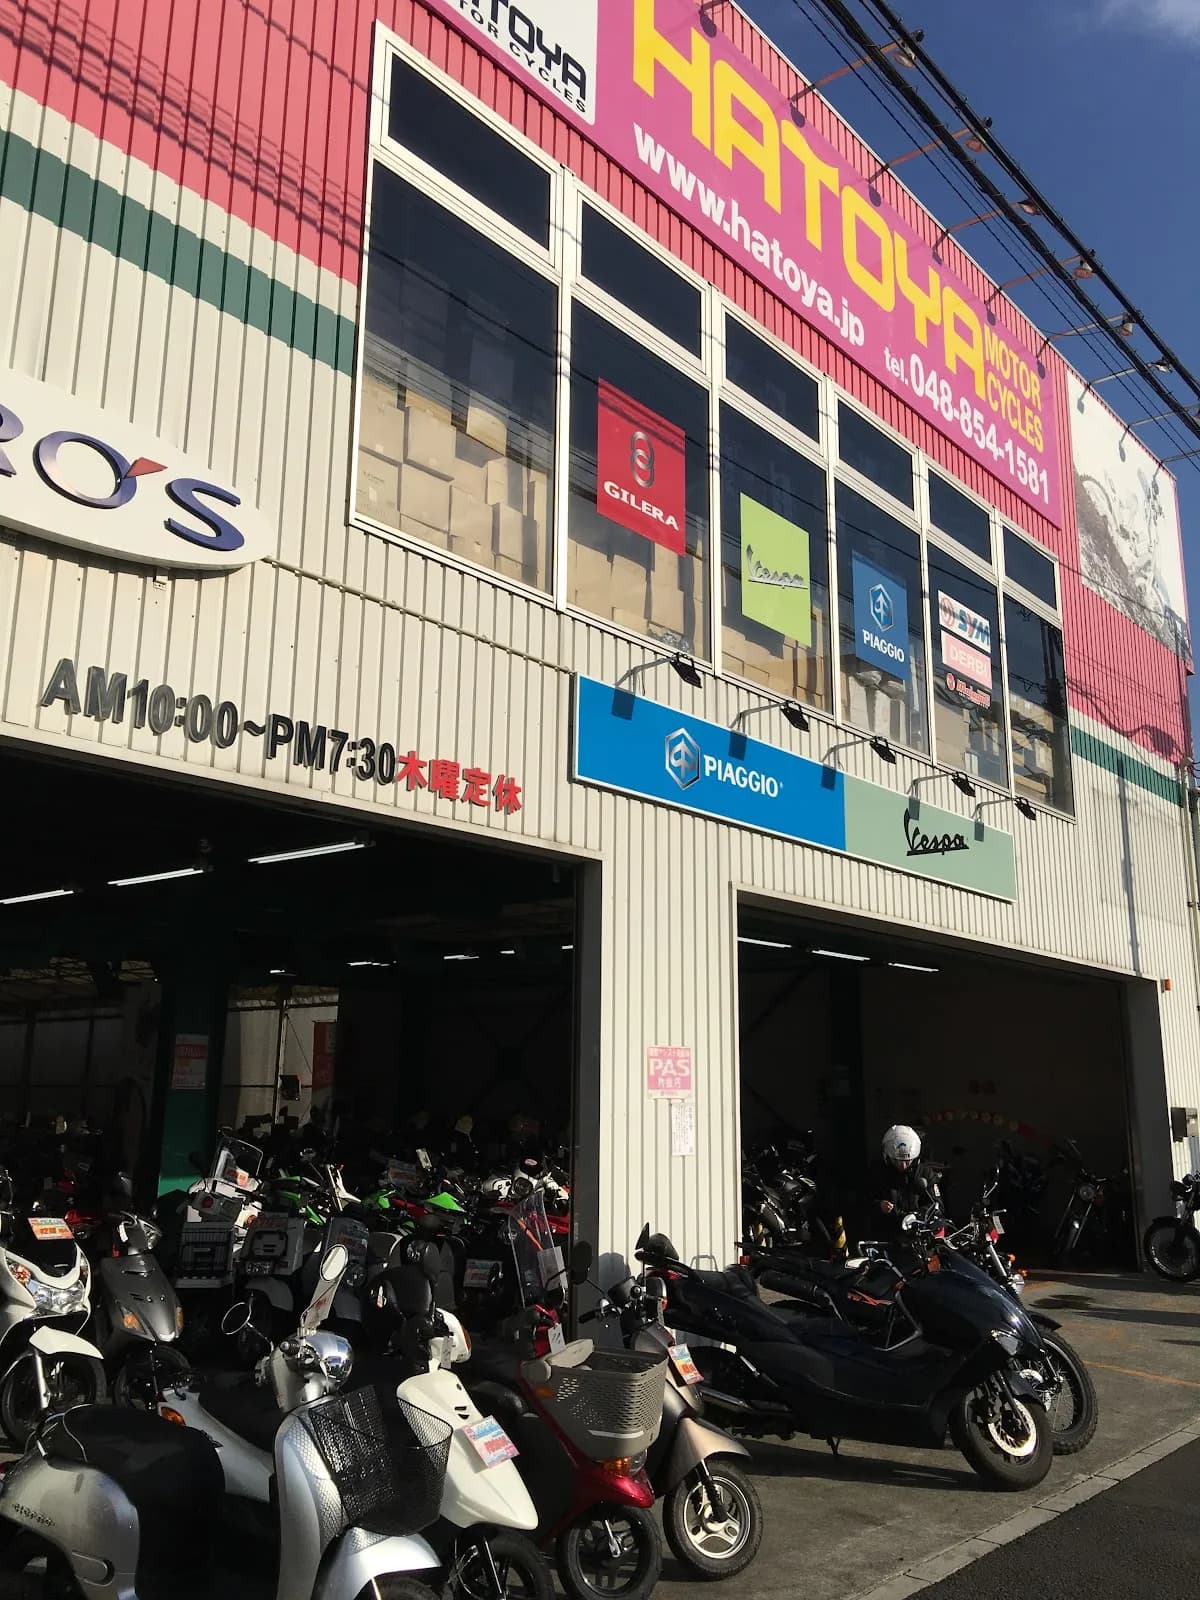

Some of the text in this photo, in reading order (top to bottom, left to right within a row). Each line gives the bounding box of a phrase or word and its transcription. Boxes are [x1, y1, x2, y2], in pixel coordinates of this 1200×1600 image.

[509, 42, 586, 113] CYCLES
[633, 0, 986, 402] HATOYA
[633, 122, 865, 347] www.hatoya.jp
[984, 321, 1042, 412] MOTOR
[986, 371, 1044, 453] CYCLES
[604, 481, 679, 531] GILERA
[745, 543, 809, 589] Vespa
[862, 628, 905, 663] PIAGGIO
[397, 750, 523, 815] 木曜定休
[704, 754, 779, 798] PIAGGIO
[903, 807, 970, 856] Vespa
[649, 1058, 690, 1077] PAS
